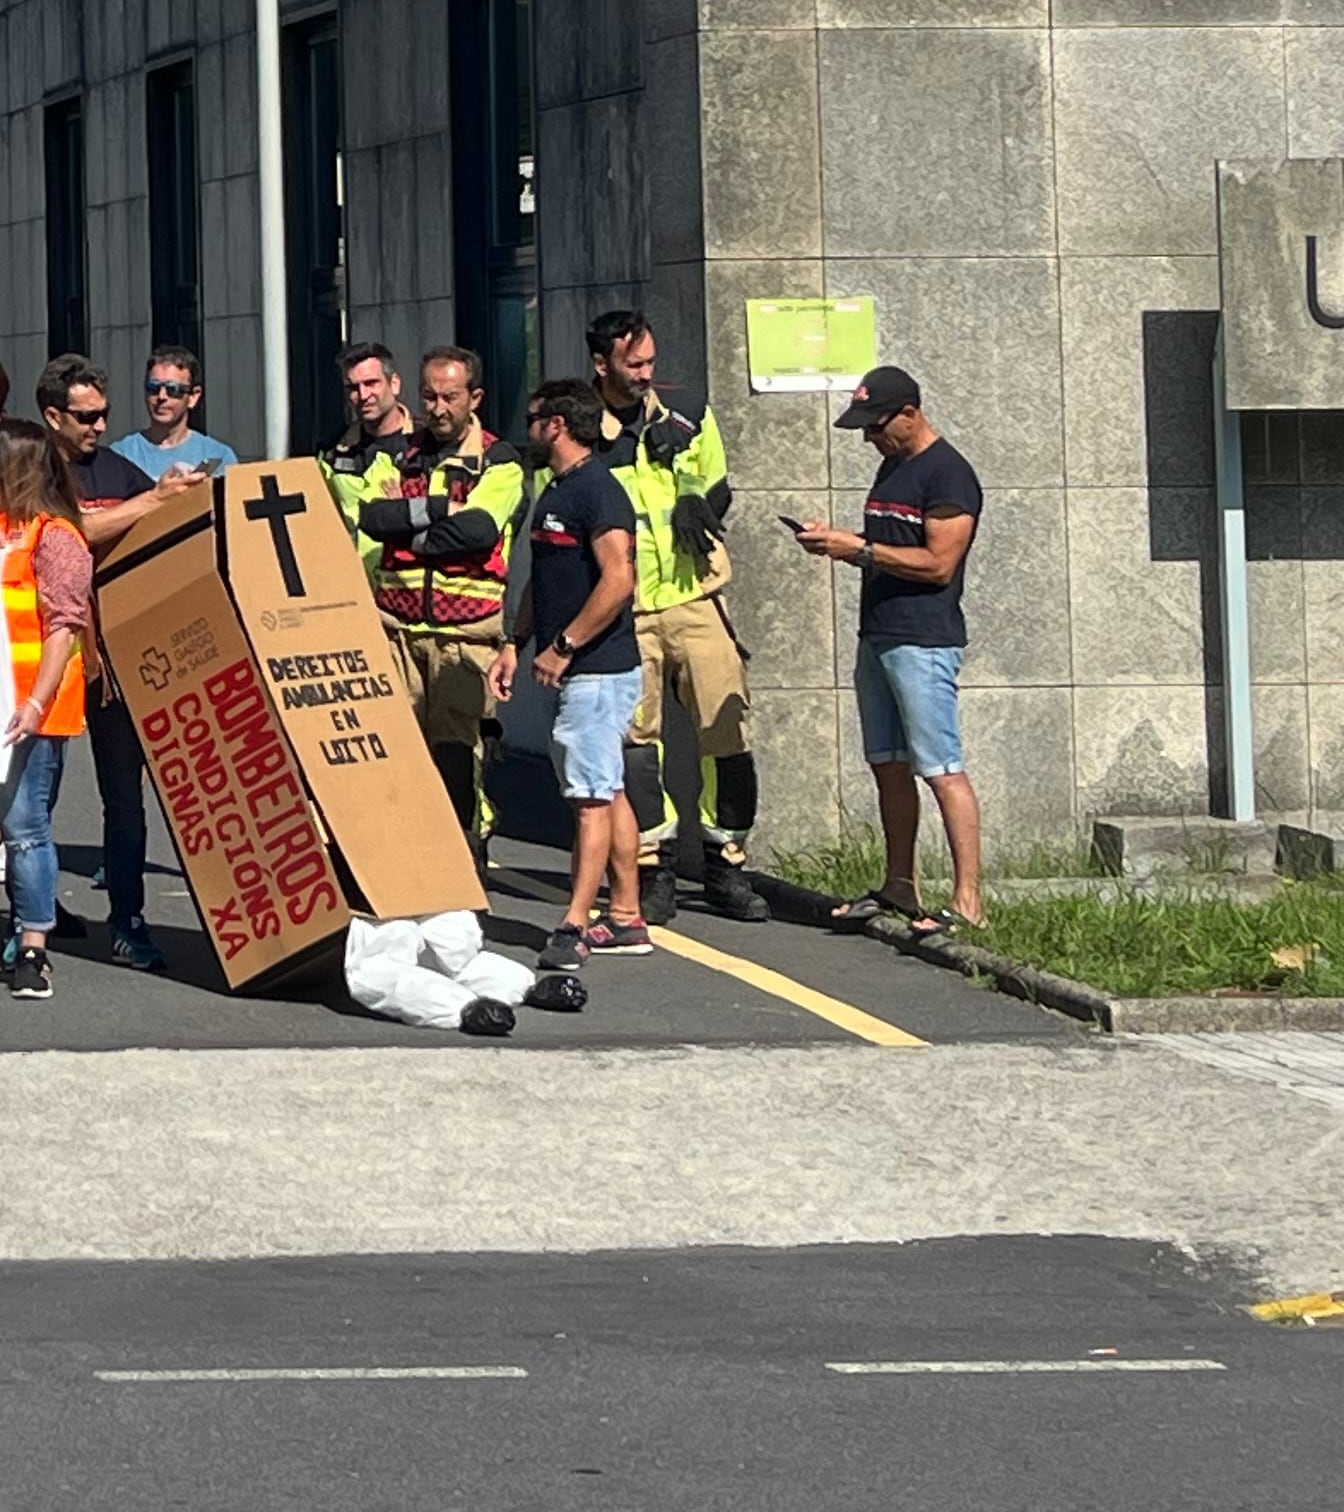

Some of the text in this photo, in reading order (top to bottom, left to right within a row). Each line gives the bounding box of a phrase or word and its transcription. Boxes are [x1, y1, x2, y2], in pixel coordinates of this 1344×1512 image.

[266, 649, 369, 683] DEREITOS
[329, 707, 361, 731] EN
[141, 707, 251, 961] DIGNAS XA
[202, 657, 338, 927] BOMBEIROS
